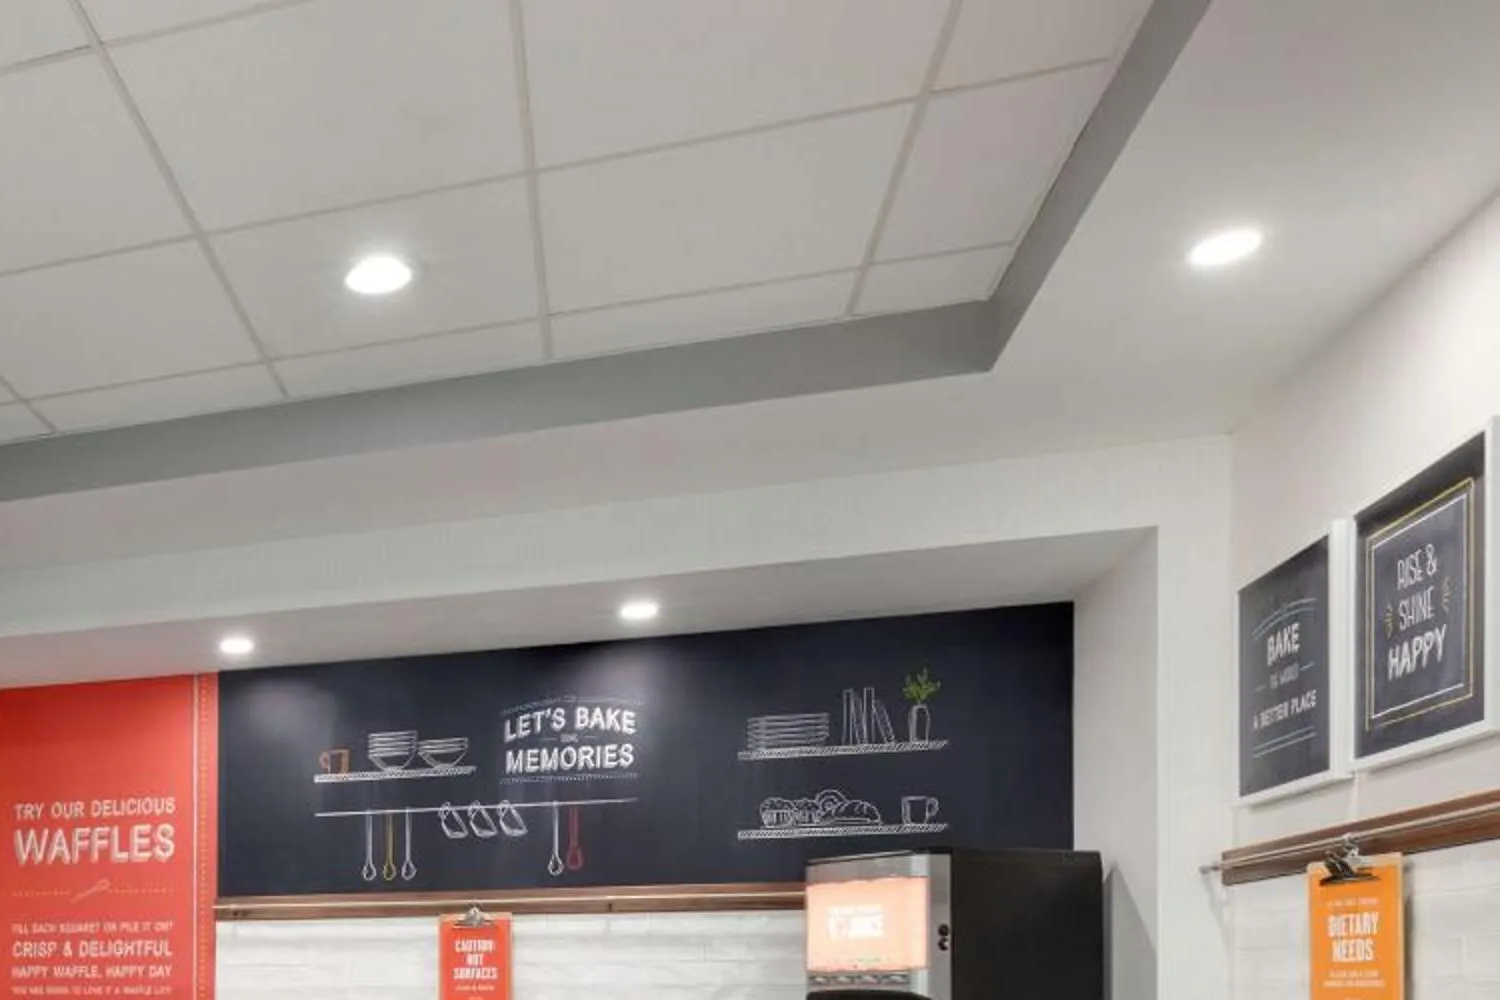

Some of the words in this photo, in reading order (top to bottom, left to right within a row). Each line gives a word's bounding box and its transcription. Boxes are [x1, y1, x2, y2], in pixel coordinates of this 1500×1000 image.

[1397, 549, 1422, 590] RISE
[1425, 543, 1438, 577] &
[1398, 585, 1435, 631] SHINE
[1267, 622, 1300, 666] BAKE
[1387, 624, 1447, 682] HAPPY
[1290, 689, 1317, 715] PLACE
[504, 707, 566, 743] LET'S
[574, 706, 637, 735] BAKE
[505, 743, 634, 774] MEMORIES
[14, 802, 45, 821] TRY
[51, 800, 84, 819] OUR
[90, 797, 176, 817] DELICIOUS
[13, 822, 175, 866] WAFFLES
[1327, 912, 1380, 938] DIETARY
[12, 940, 57, 958] CRISP
[62, 940, 73, 957] &
[79, 938, 173, 957] DELIGHTFUL
[1331, 938, 1374, 962] NEEDS
[11, 965, 48, 979] HAPPY
[106, 965, 146, 978] HAPPY
[149, 964, 172, 977] DAY
